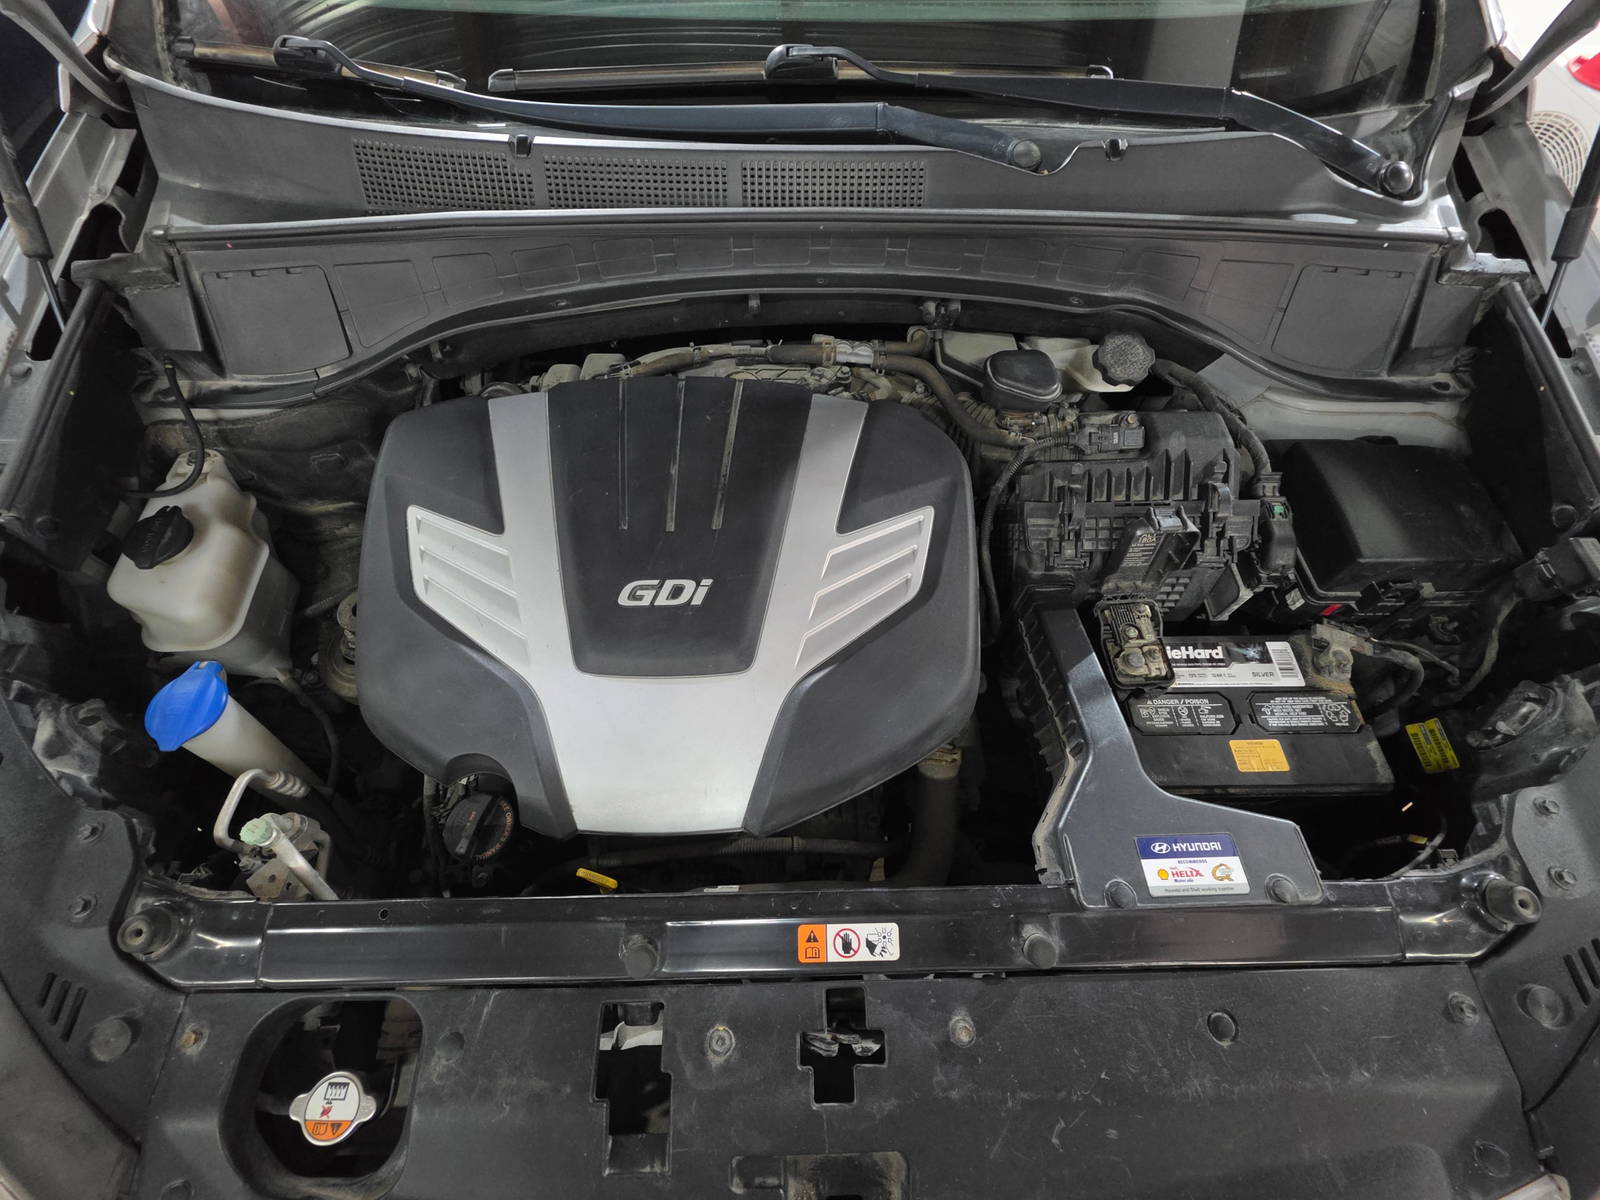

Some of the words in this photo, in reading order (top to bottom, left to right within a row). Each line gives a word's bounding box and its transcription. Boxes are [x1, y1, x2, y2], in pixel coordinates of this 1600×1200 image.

[617, 578, 714, 606] GDi
[1166, 646, 1224, 659] ieHard
[1172, 842, 1222, 852] HYUNDAI
[1171, 867, 1205, 878] HELIX
